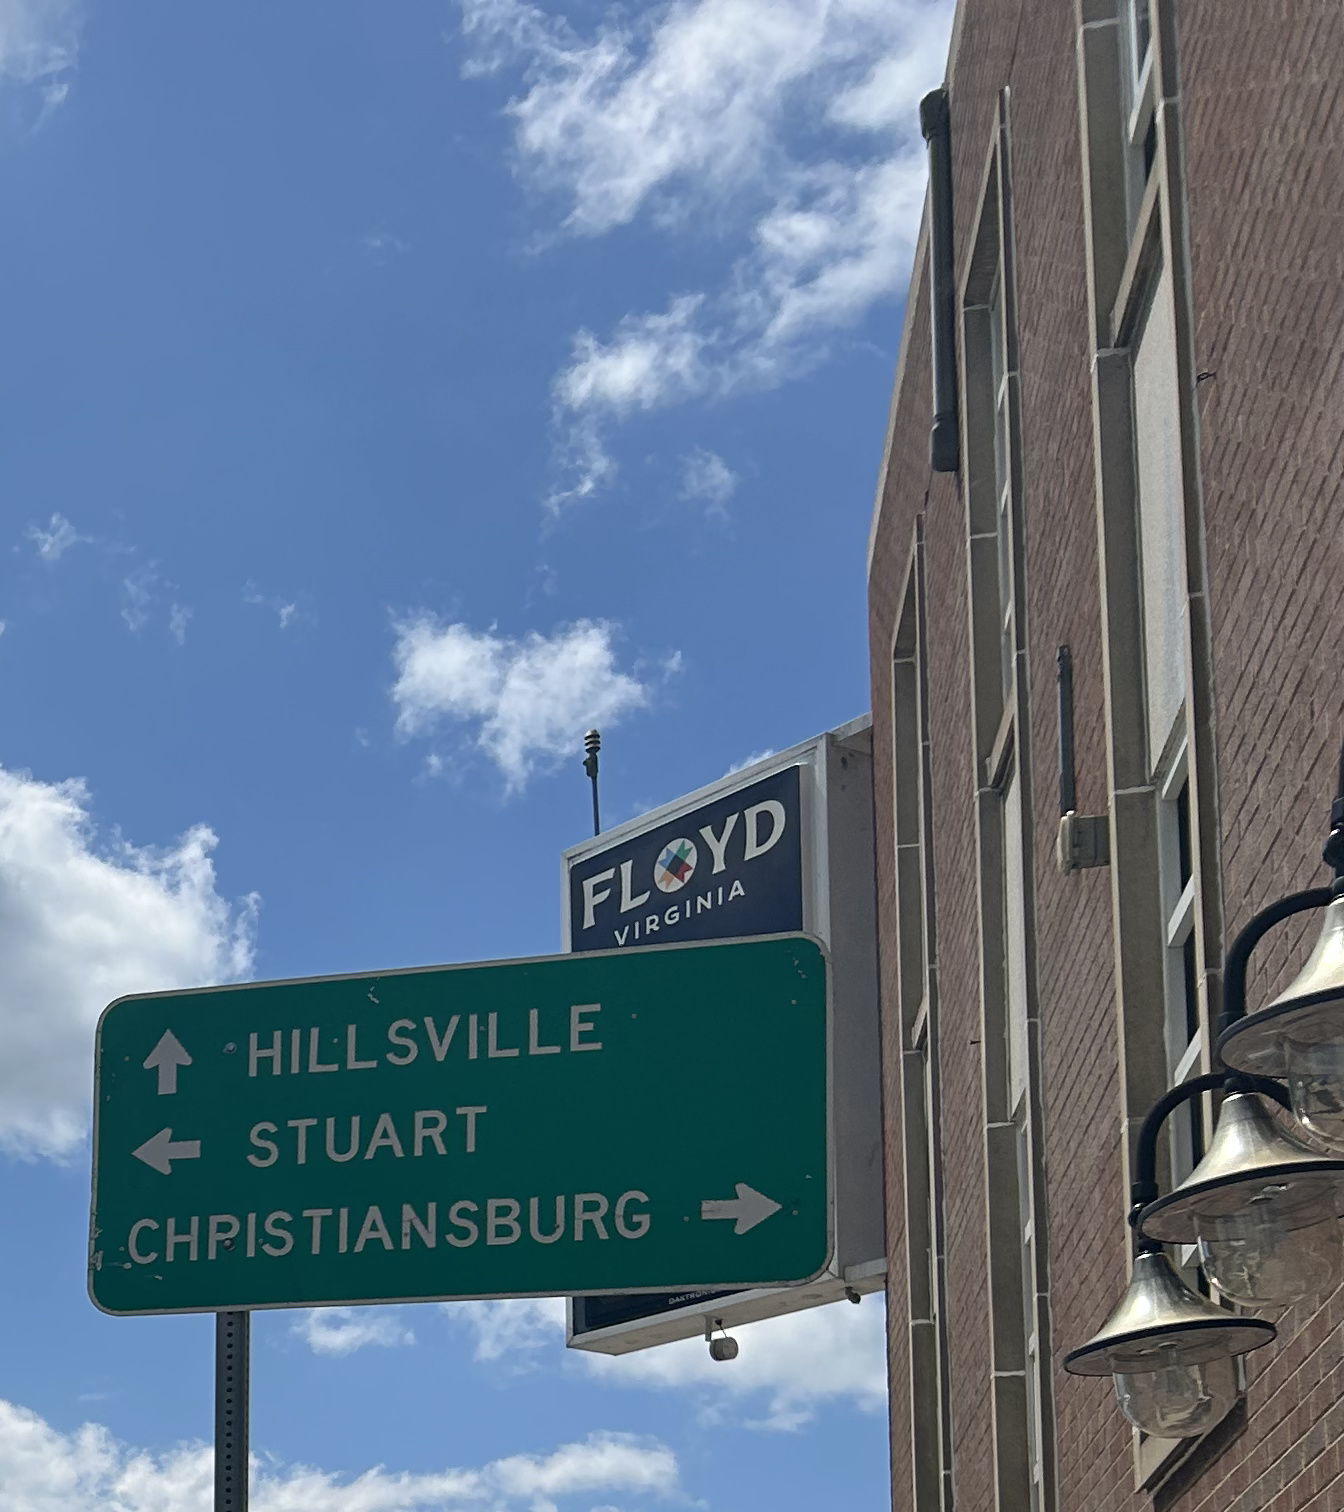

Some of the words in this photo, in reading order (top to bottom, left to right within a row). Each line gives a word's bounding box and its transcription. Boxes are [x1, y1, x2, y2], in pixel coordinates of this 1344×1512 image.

[582, 800, 786, 930] FLOYD
[614, 879, 746, 947] VIRGINIA
[248, 1003, 603, 1077] HILLSVILLE
[247, 1106, 488, 1168] STUART
